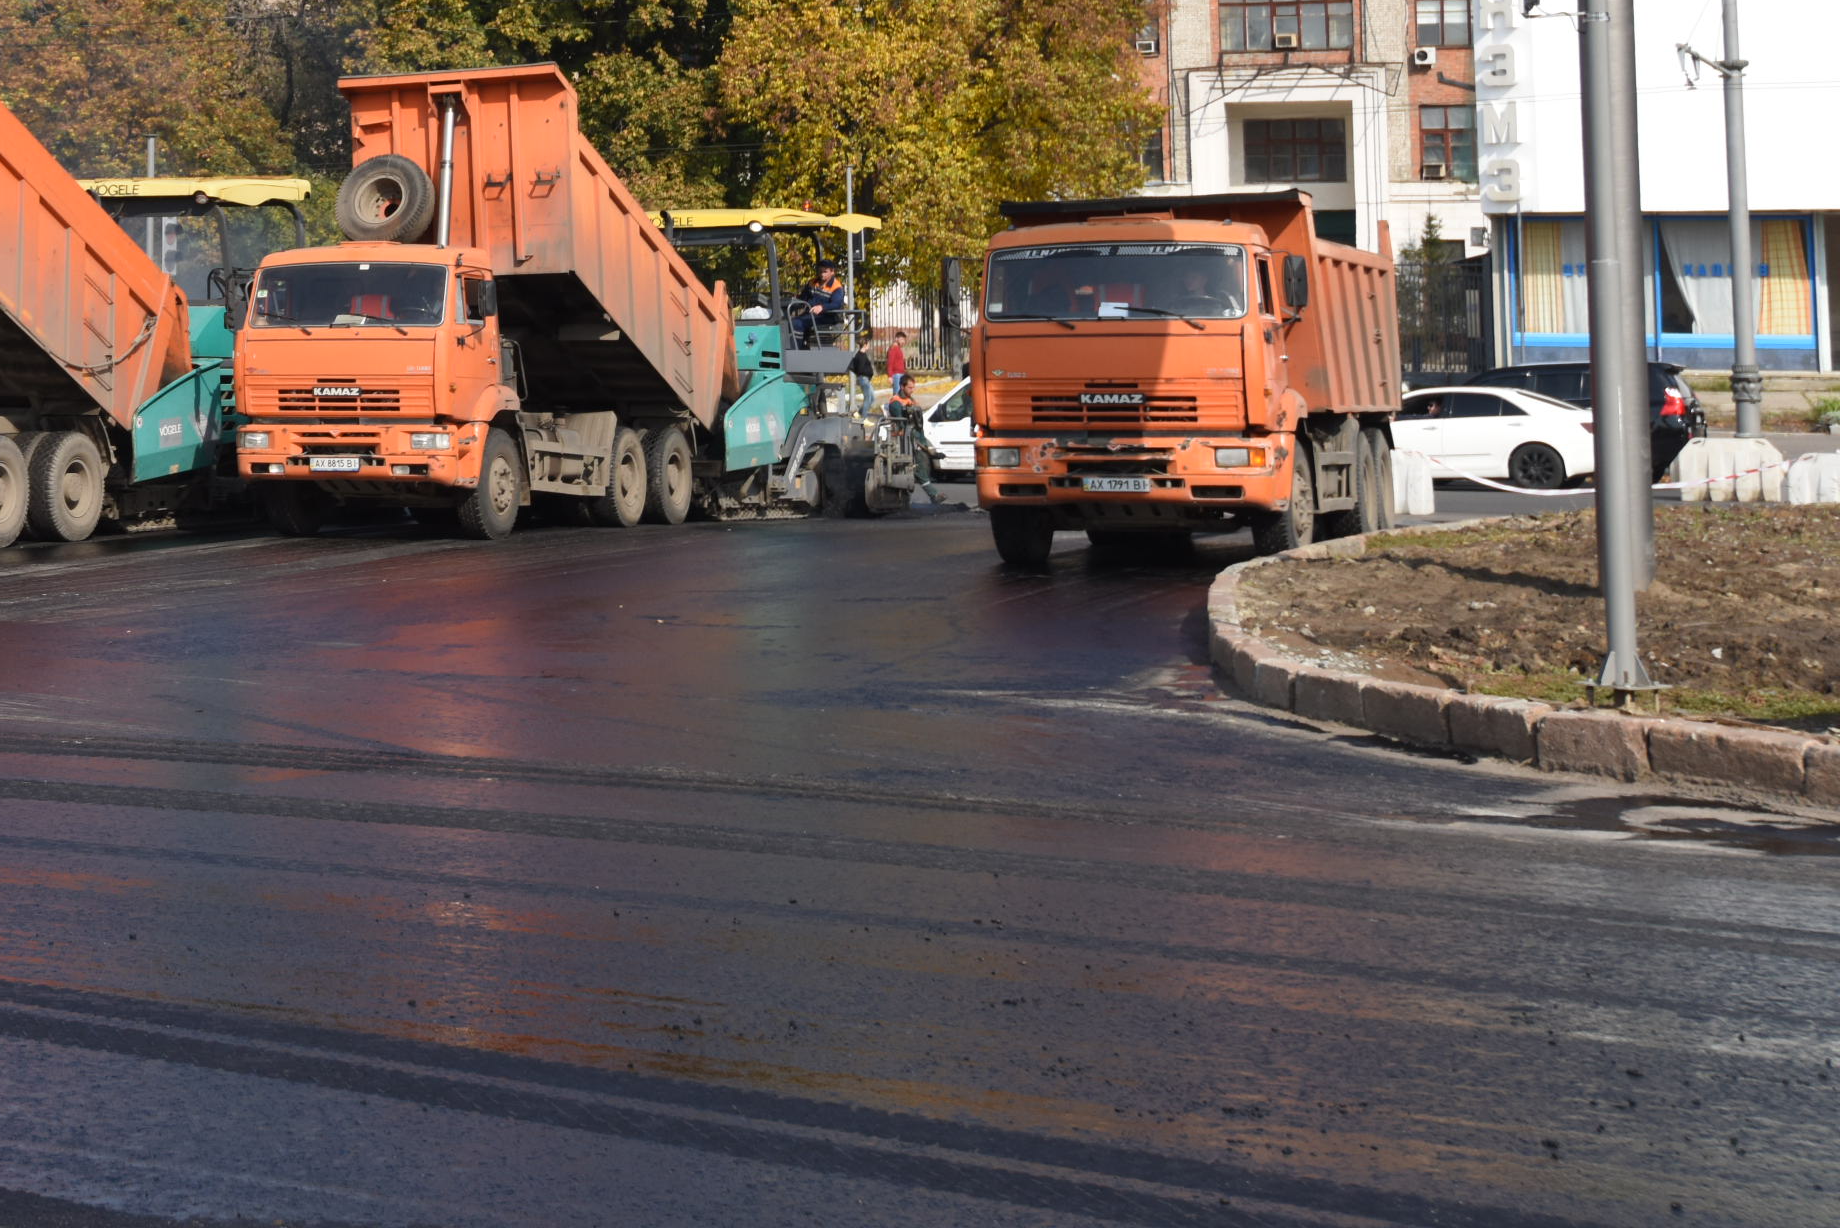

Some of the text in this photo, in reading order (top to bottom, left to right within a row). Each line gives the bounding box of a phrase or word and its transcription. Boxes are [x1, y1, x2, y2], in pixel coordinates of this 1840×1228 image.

[313, 387, 360, 396] KAMAZ
[1080, 394, 1143, 404] KAMAZ
[315, 459, 326, 468] AX
[327, 459, 345, 468] 8815
[1090, 480, 1104, 489] AX
[1107, 480, 1129, 490] 1791
